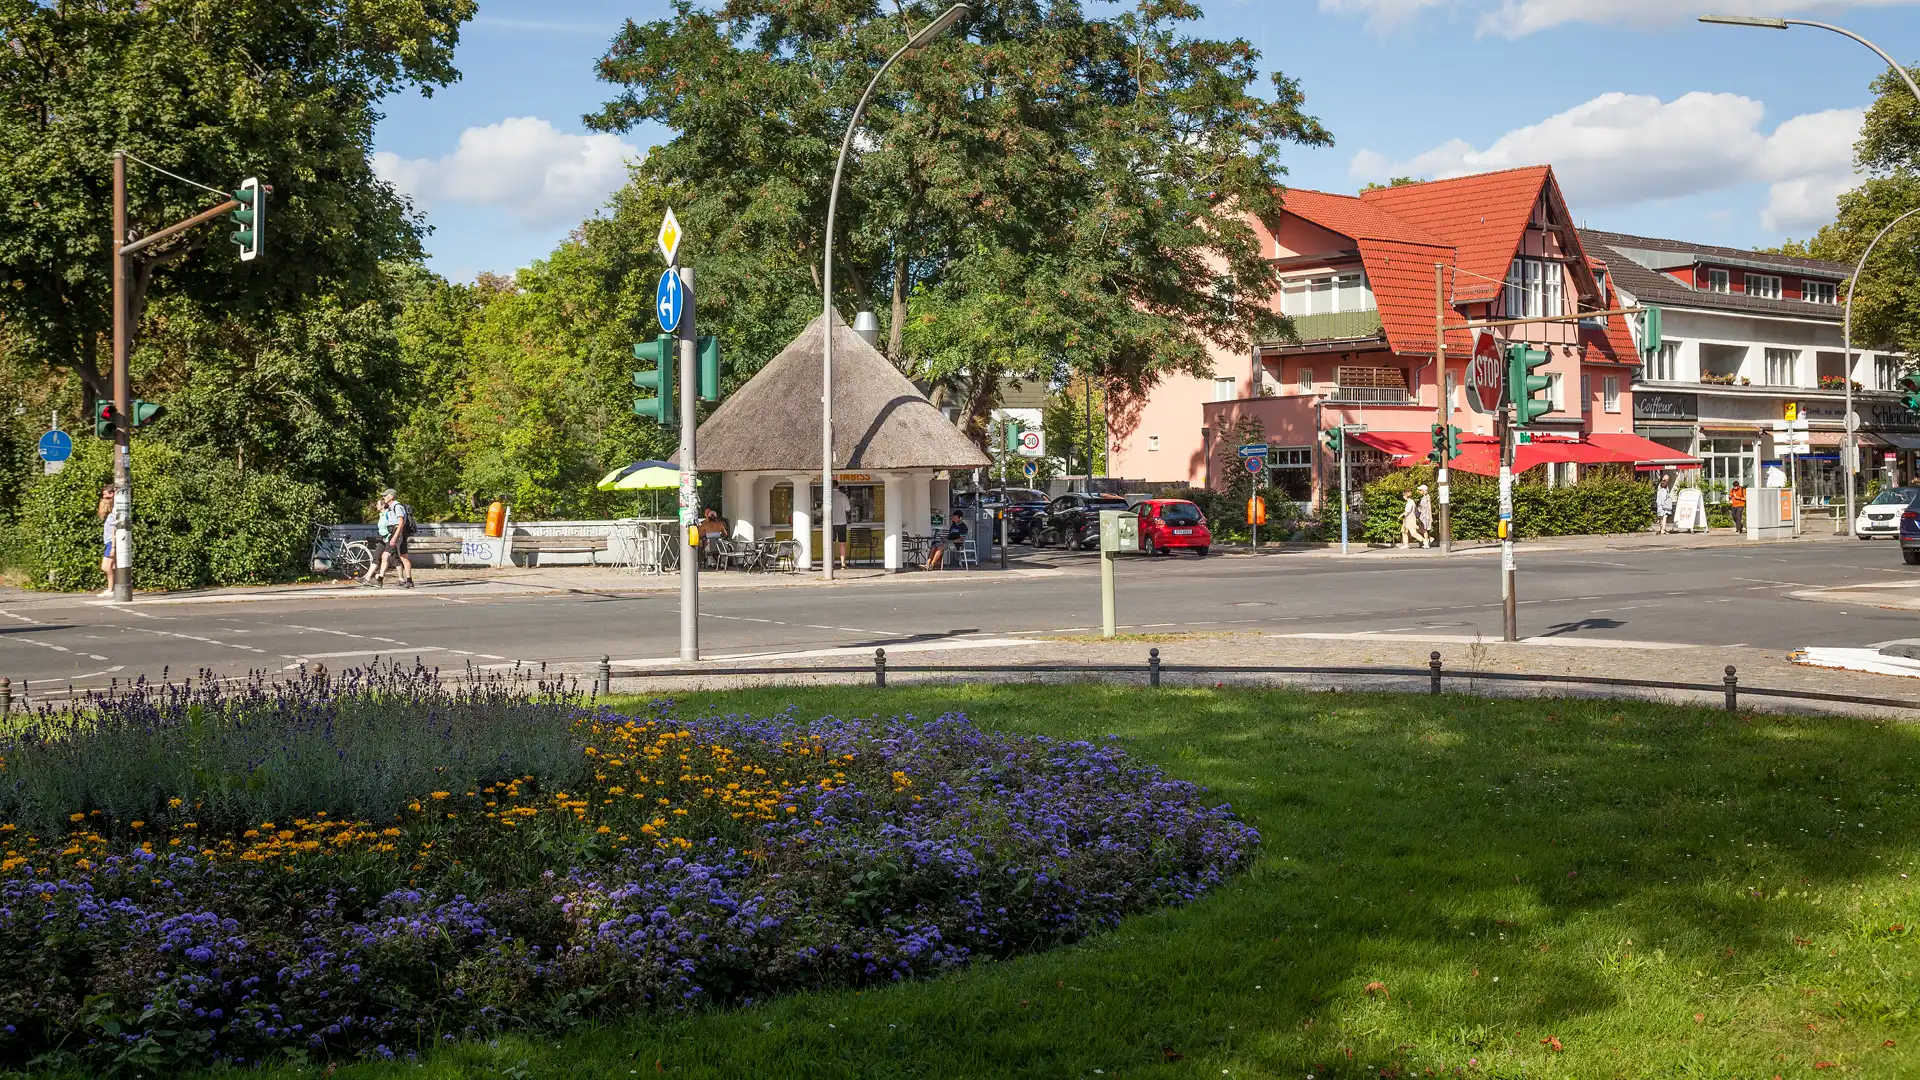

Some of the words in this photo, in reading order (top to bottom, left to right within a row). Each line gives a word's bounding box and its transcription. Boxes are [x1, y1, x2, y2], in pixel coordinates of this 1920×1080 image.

[1476, 354, 1500, 388] STOP
[1640, 396, 1673, 418] Coiffeur
[1026, 437, 1037, 446] 30
[839, 473, 871, 481] IMBISS
